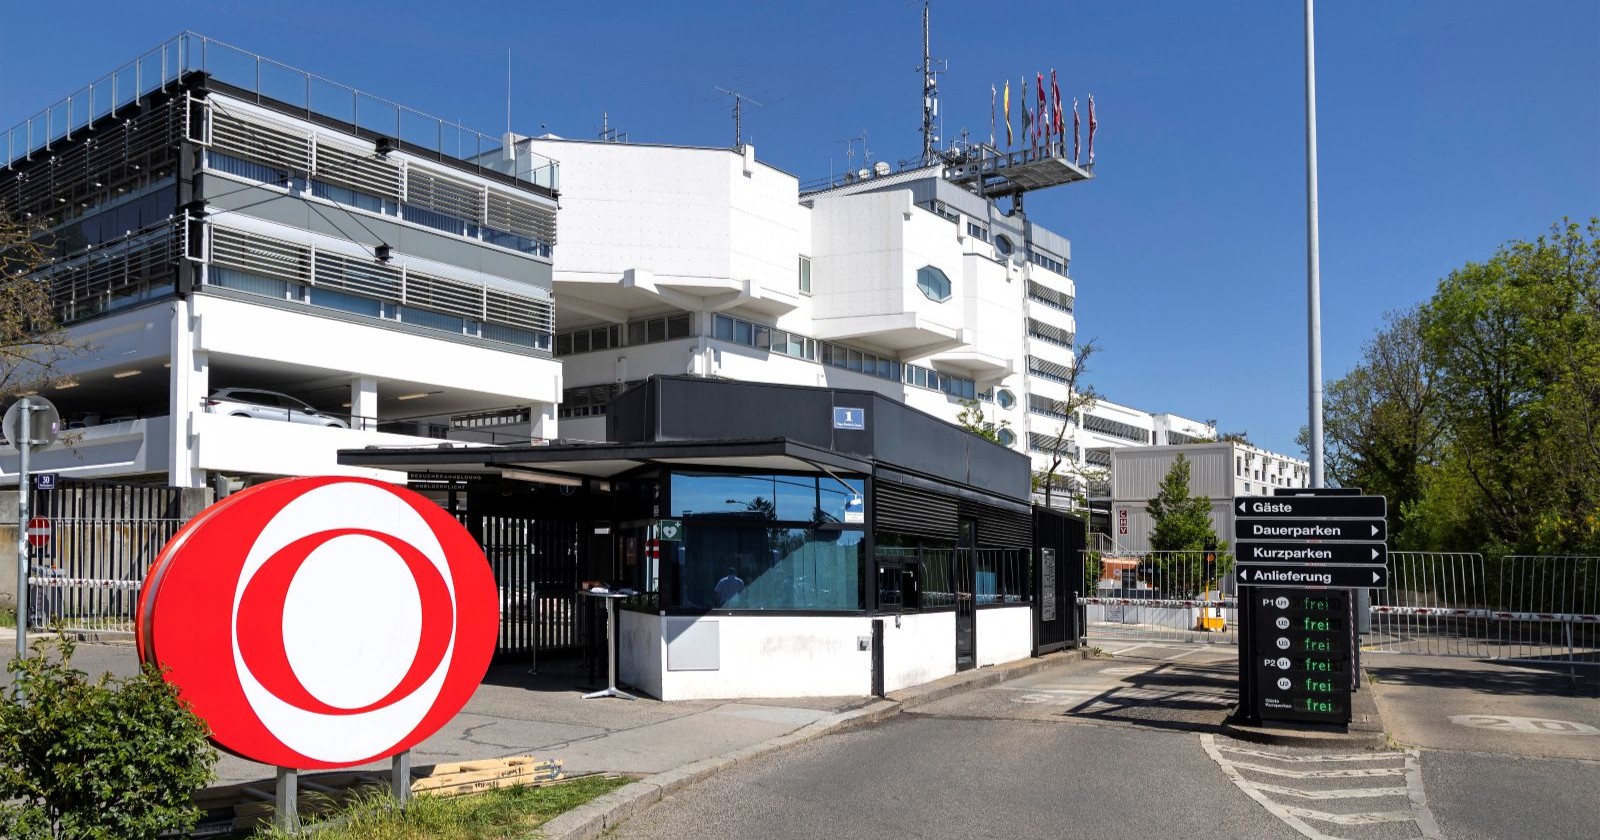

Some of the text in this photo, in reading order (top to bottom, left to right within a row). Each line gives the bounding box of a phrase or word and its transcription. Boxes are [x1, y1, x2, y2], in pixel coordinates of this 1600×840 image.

[844, 411, 853, 422] 1
[42, 475, 50, 483] 30
[1253, 502, 1292, 513] Gäste
[1253, 525, 1341, 539] Dauerparken
[1253, 548, 1332, 561] Kurzparken
[1254, 570, 1332, 584] Anlieferung
[1263, 598, 1274, 607] P1
[1304, 597, 1328, 610] frei
[1304, 617, 1329, 630] frei
[1305, 638, 1330, 651] frei
[1264, 659, 1276, 667] P2
[1305, 658, 1331, 672] frei
[1306, 678, 1331, 692] frei
[1306, 698, 1332, 712] frei
